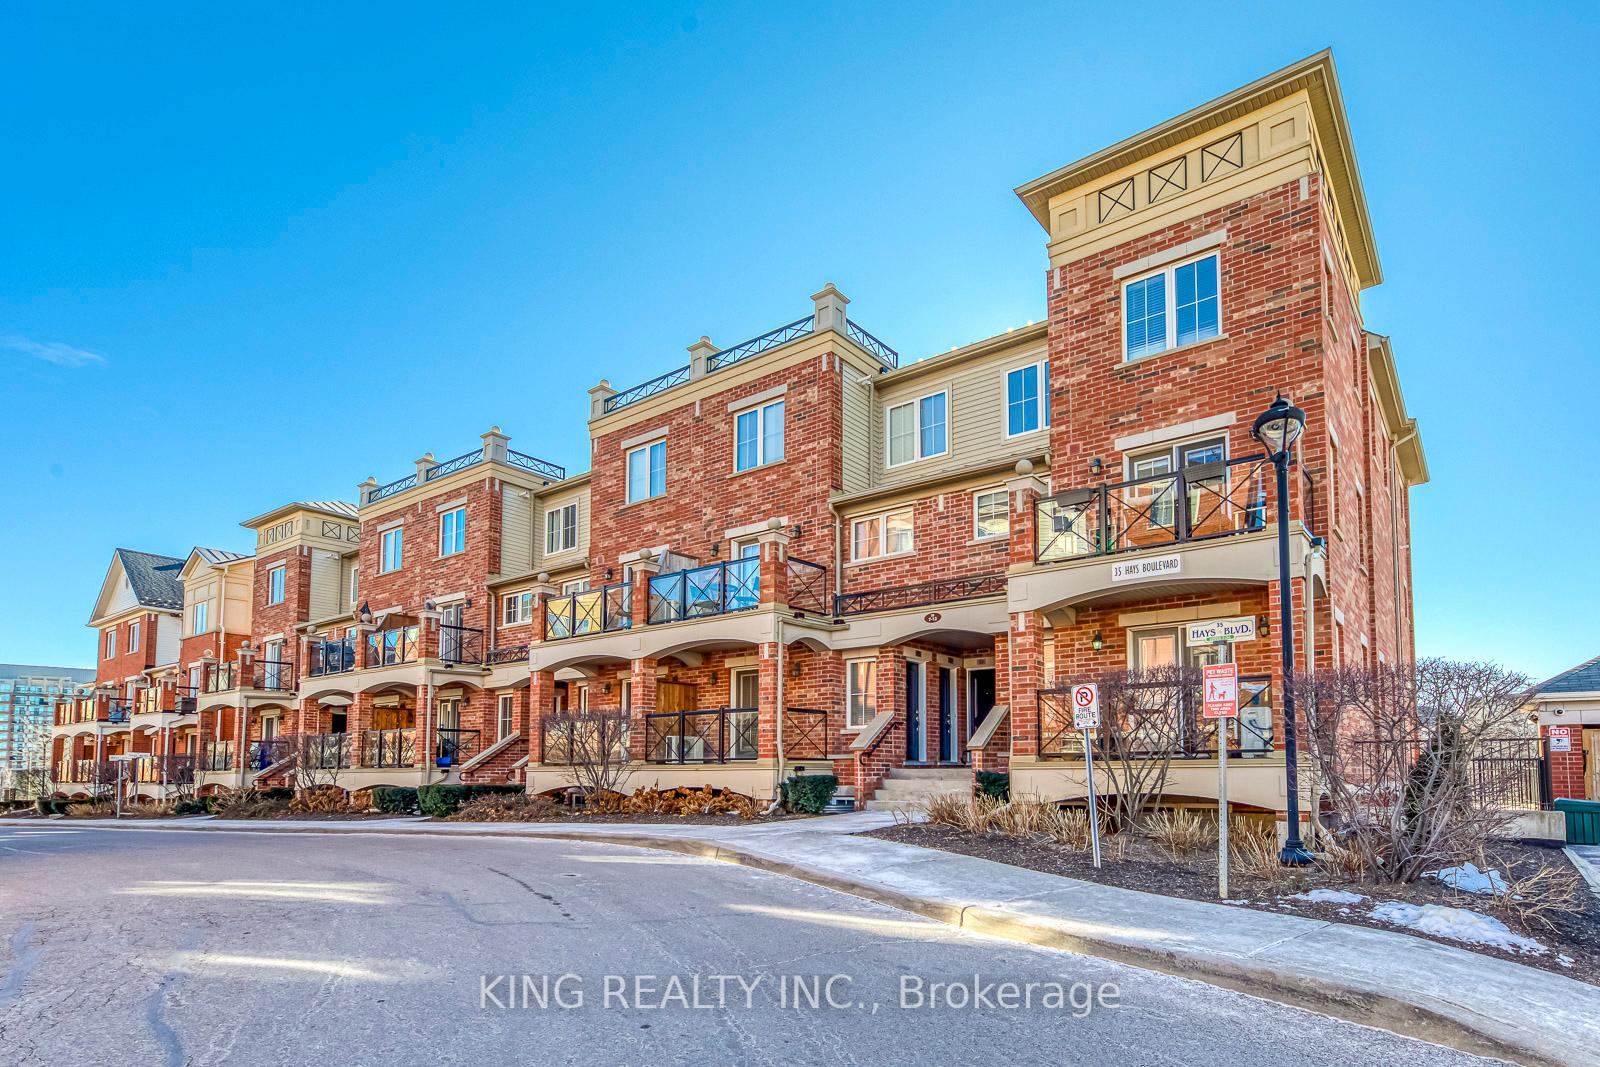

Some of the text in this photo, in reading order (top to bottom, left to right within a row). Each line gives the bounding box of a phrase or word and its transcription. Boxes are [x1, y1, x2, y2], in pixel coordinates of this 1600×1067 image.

[1114, 559, 1179, 577] 35 HAYS BOULEVARD
[1192, 629, 1216, 638] HAYS
[1224, 624, 1252, 635] BLVD.
[1075, 712, 1096, 720] ROUTE
